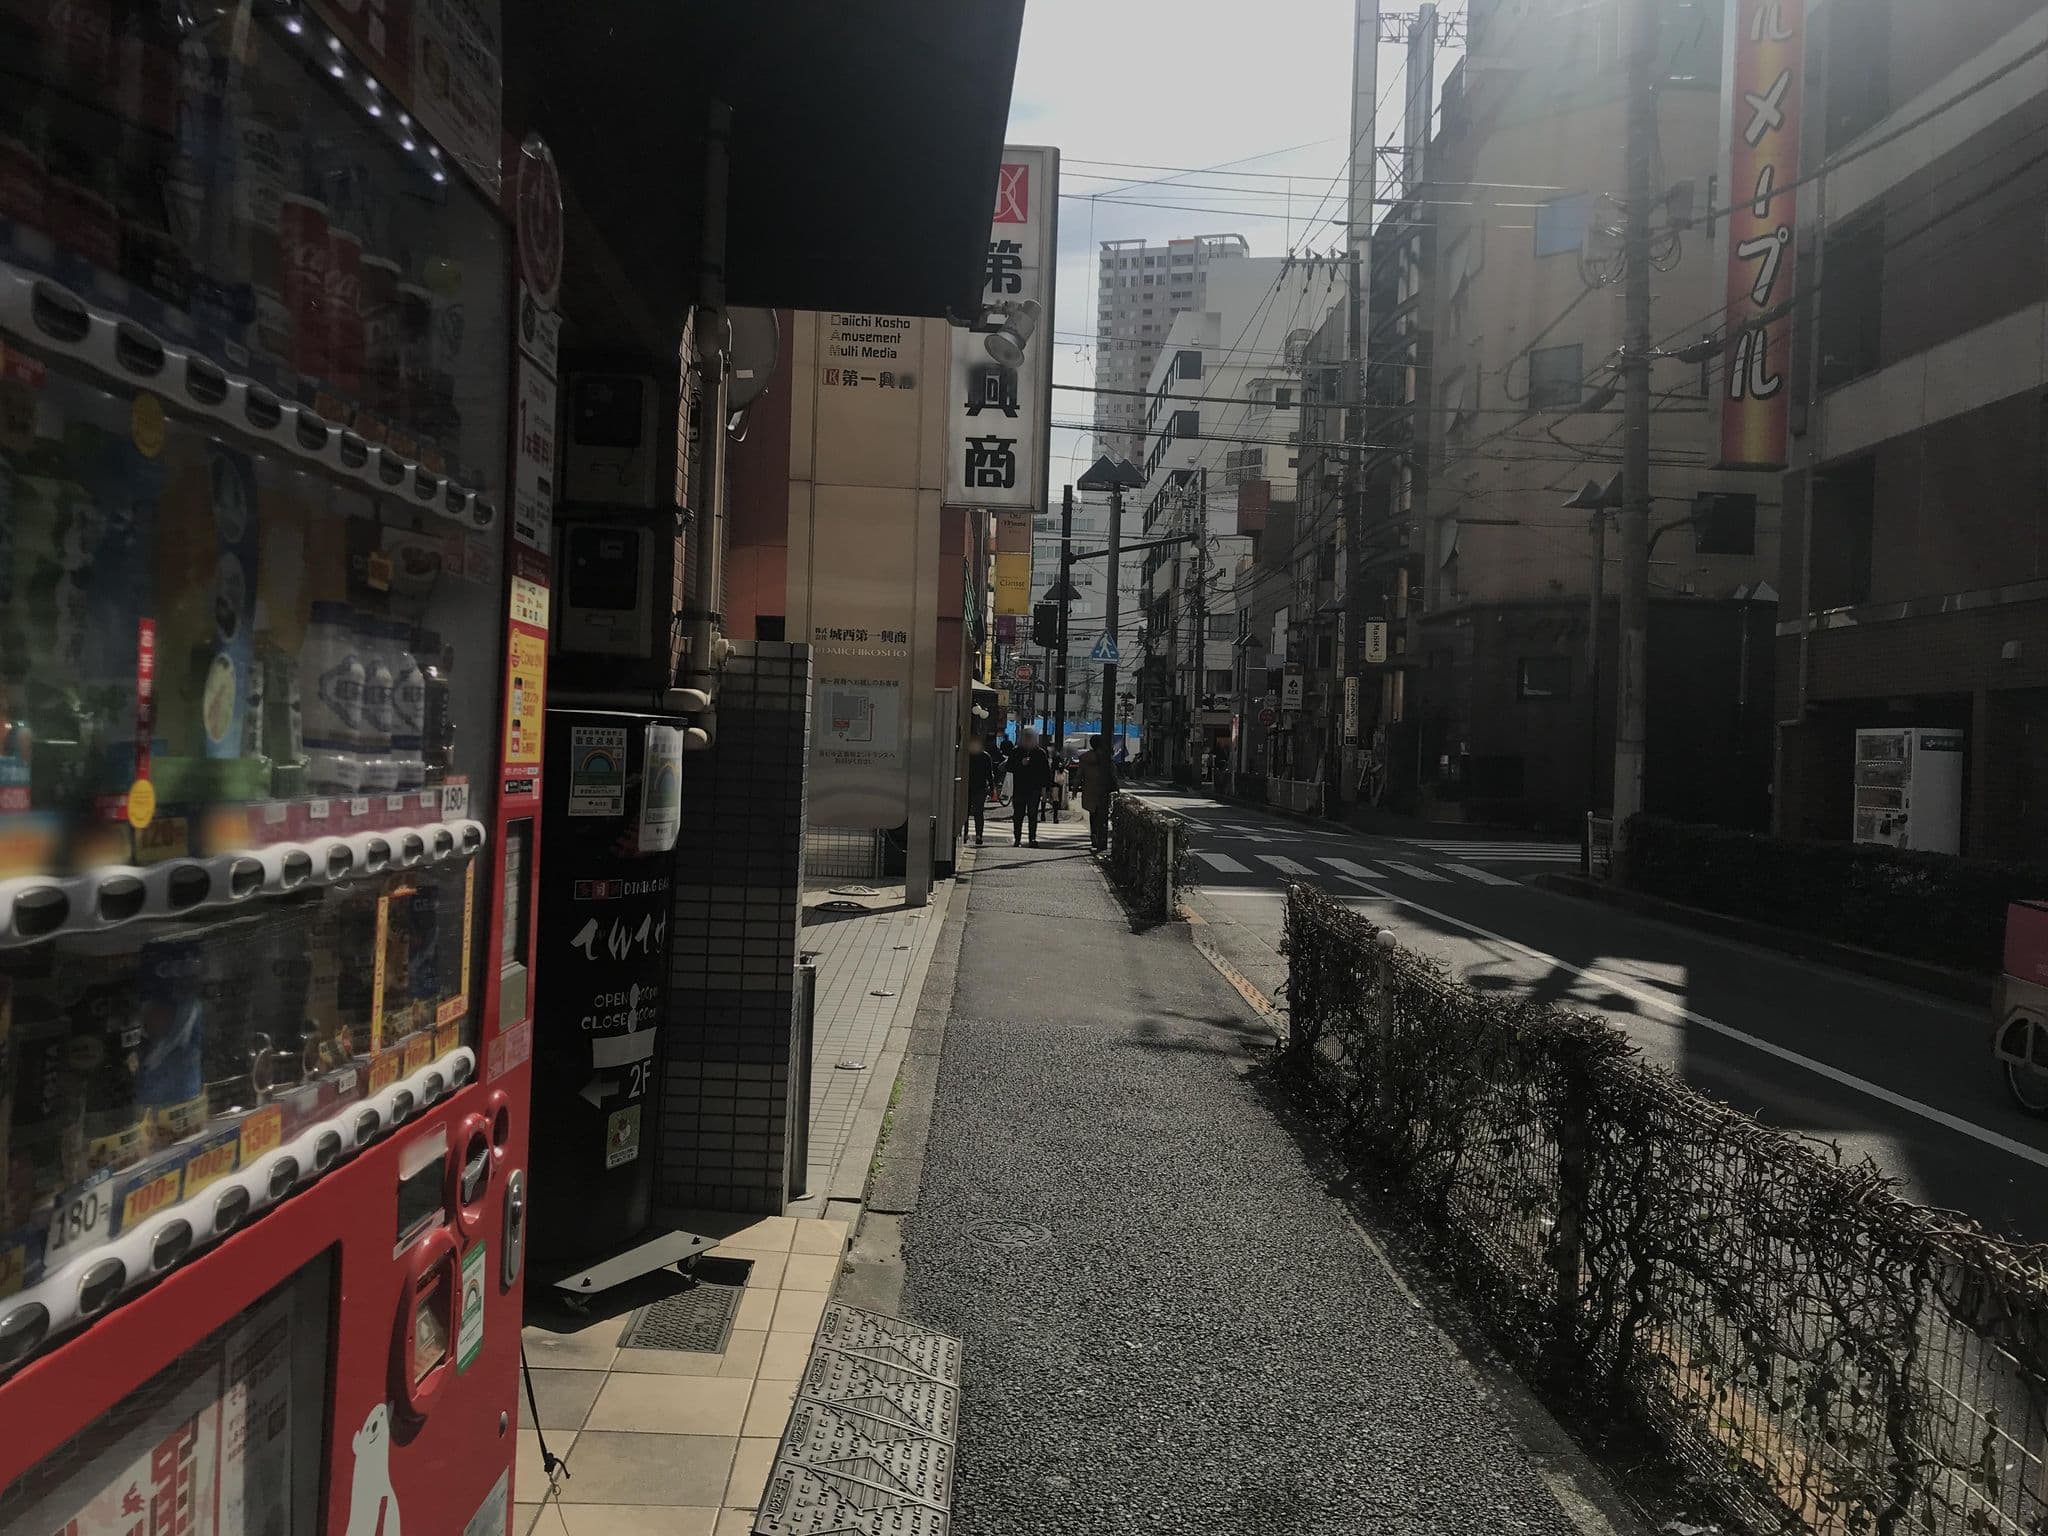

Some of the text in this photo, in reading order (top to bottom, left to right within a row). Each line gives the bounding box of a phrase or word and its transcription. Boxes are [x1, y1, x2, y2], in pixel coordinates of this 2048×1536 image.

[831, 314, 911, 329] Daiichi Kosho
[829, 329, 902, 344] Amusement
[829, 344, 898, 359] Multi Media
[593, 991, 629, 1008] OPEN
[580, 1011, 628, 1030] CLOSE
[628, 1059, 652, 1099] 2F
